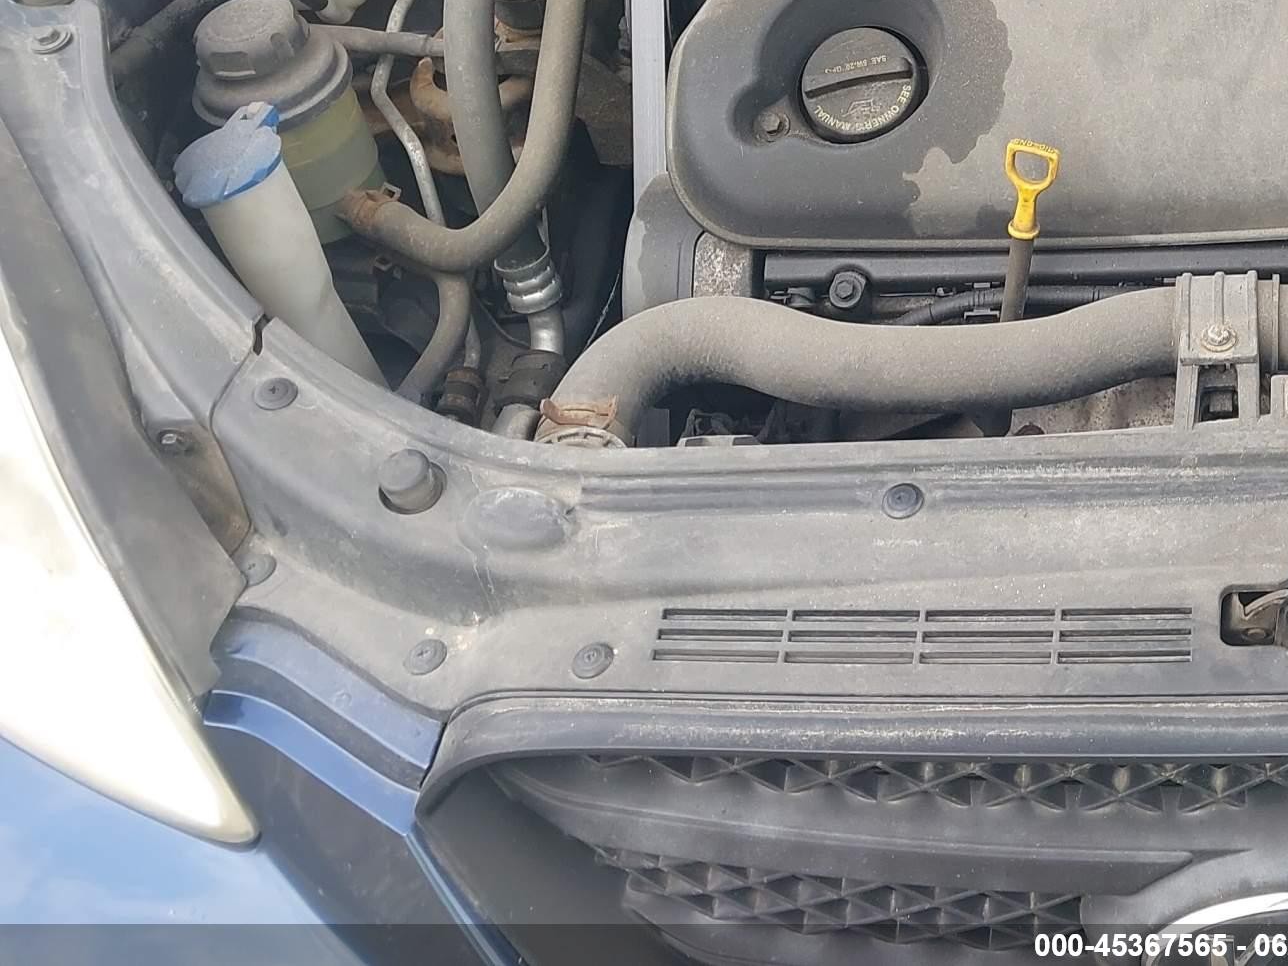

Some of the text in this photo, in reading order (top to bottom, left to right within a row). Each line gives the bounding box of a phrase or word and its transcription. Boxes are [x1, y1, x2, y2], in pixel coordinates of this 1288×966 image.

[871, 55, 887, 65] SAE
[813, 84, 912, 132] SEE OWNER'S MANUAL
